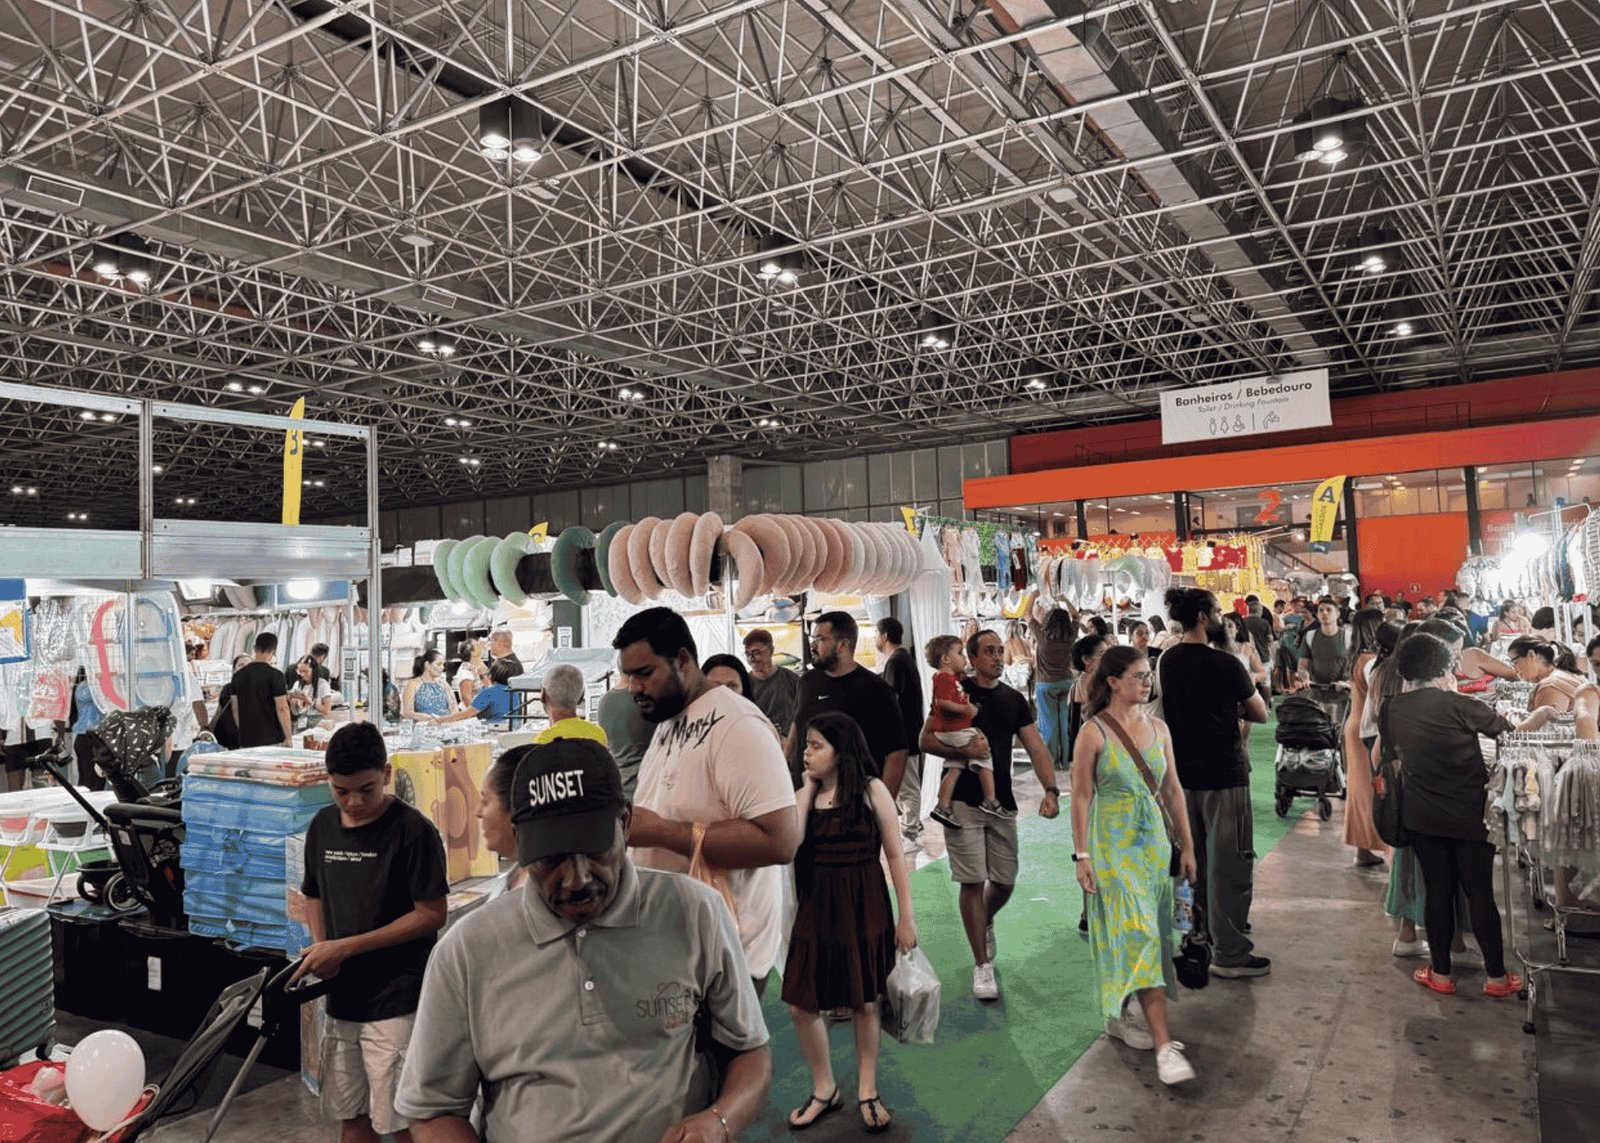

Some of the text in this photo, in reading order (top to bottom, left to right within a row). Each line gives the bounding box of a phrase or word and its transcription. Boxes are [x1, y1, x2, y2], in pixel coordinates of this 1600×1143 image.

[1175, 382, 1313, 407] Banheiros / Bebedouro
[1224, 400, 1255, 410] Drinking
[1253, 490, 1283, 523] 2
[1318, 486, 1335, 503] A
[529, 769, 584, 807] SUNSET
